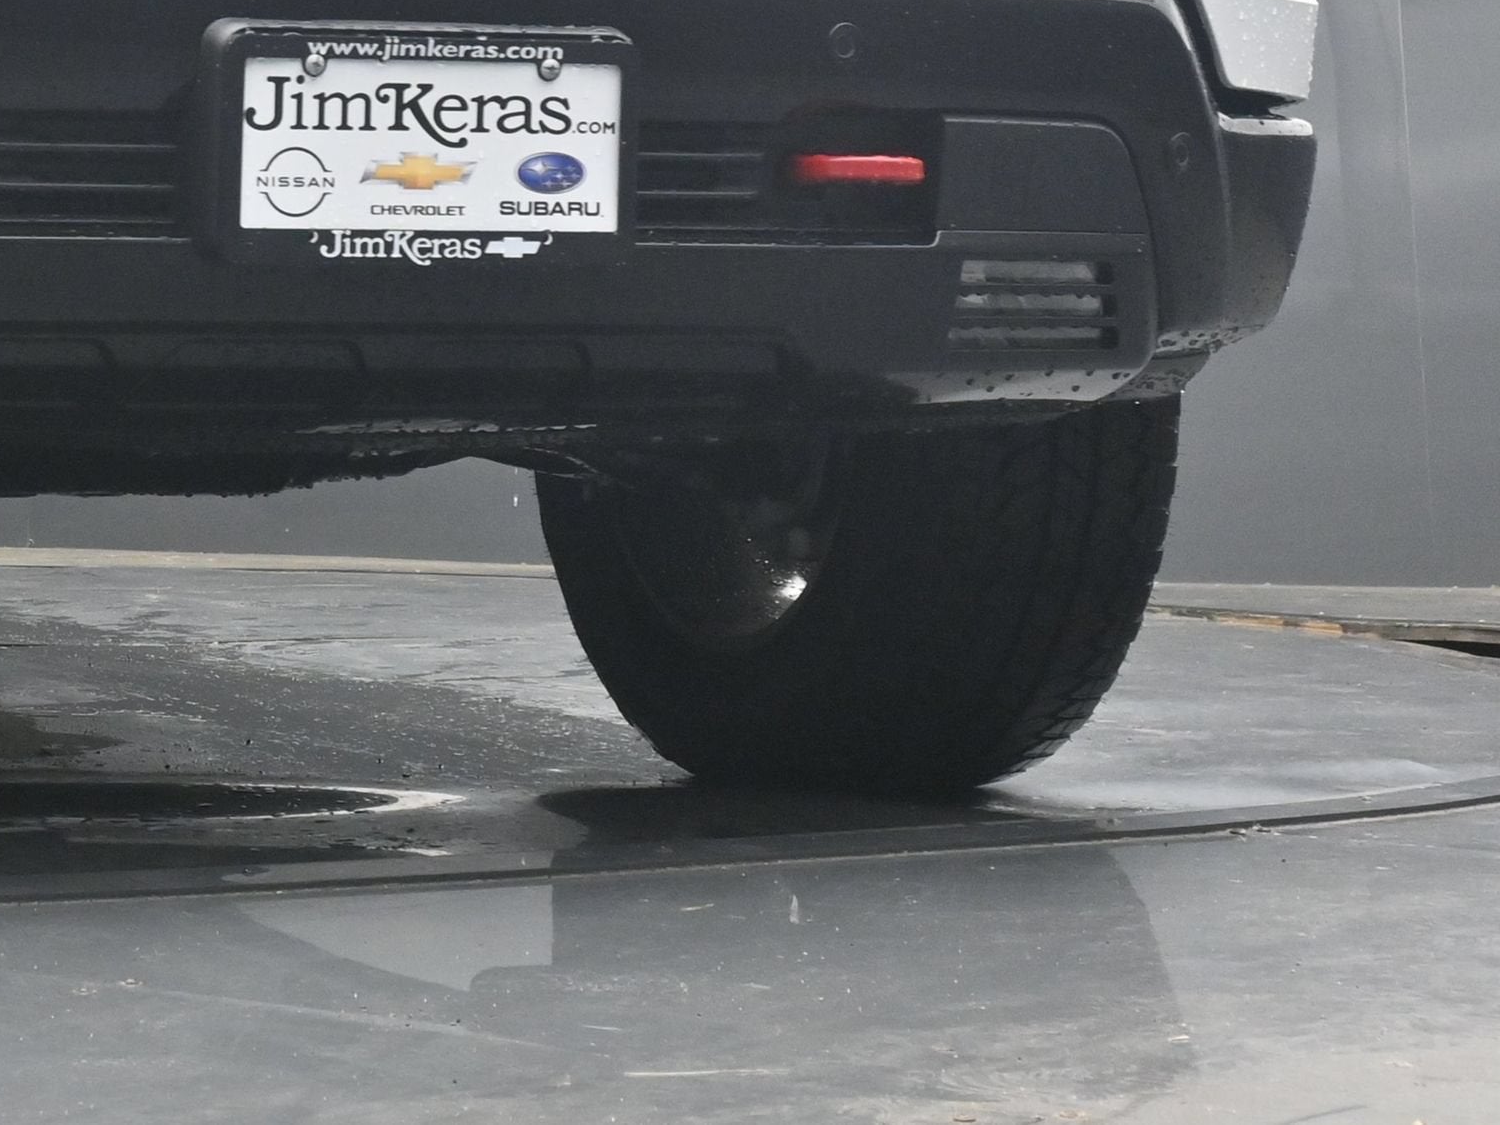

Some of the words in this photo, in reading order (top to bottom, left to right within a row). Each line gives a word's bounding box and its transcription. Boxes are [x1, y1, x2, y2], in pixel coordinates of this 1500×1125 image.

[307, 37, 564, 61] www.jimkeras.com
[256, 175, 336, 189] NISSAN
[370, 203, 466, 216] CHEVROLET
[499, 200, 601, 217] SUBARU
